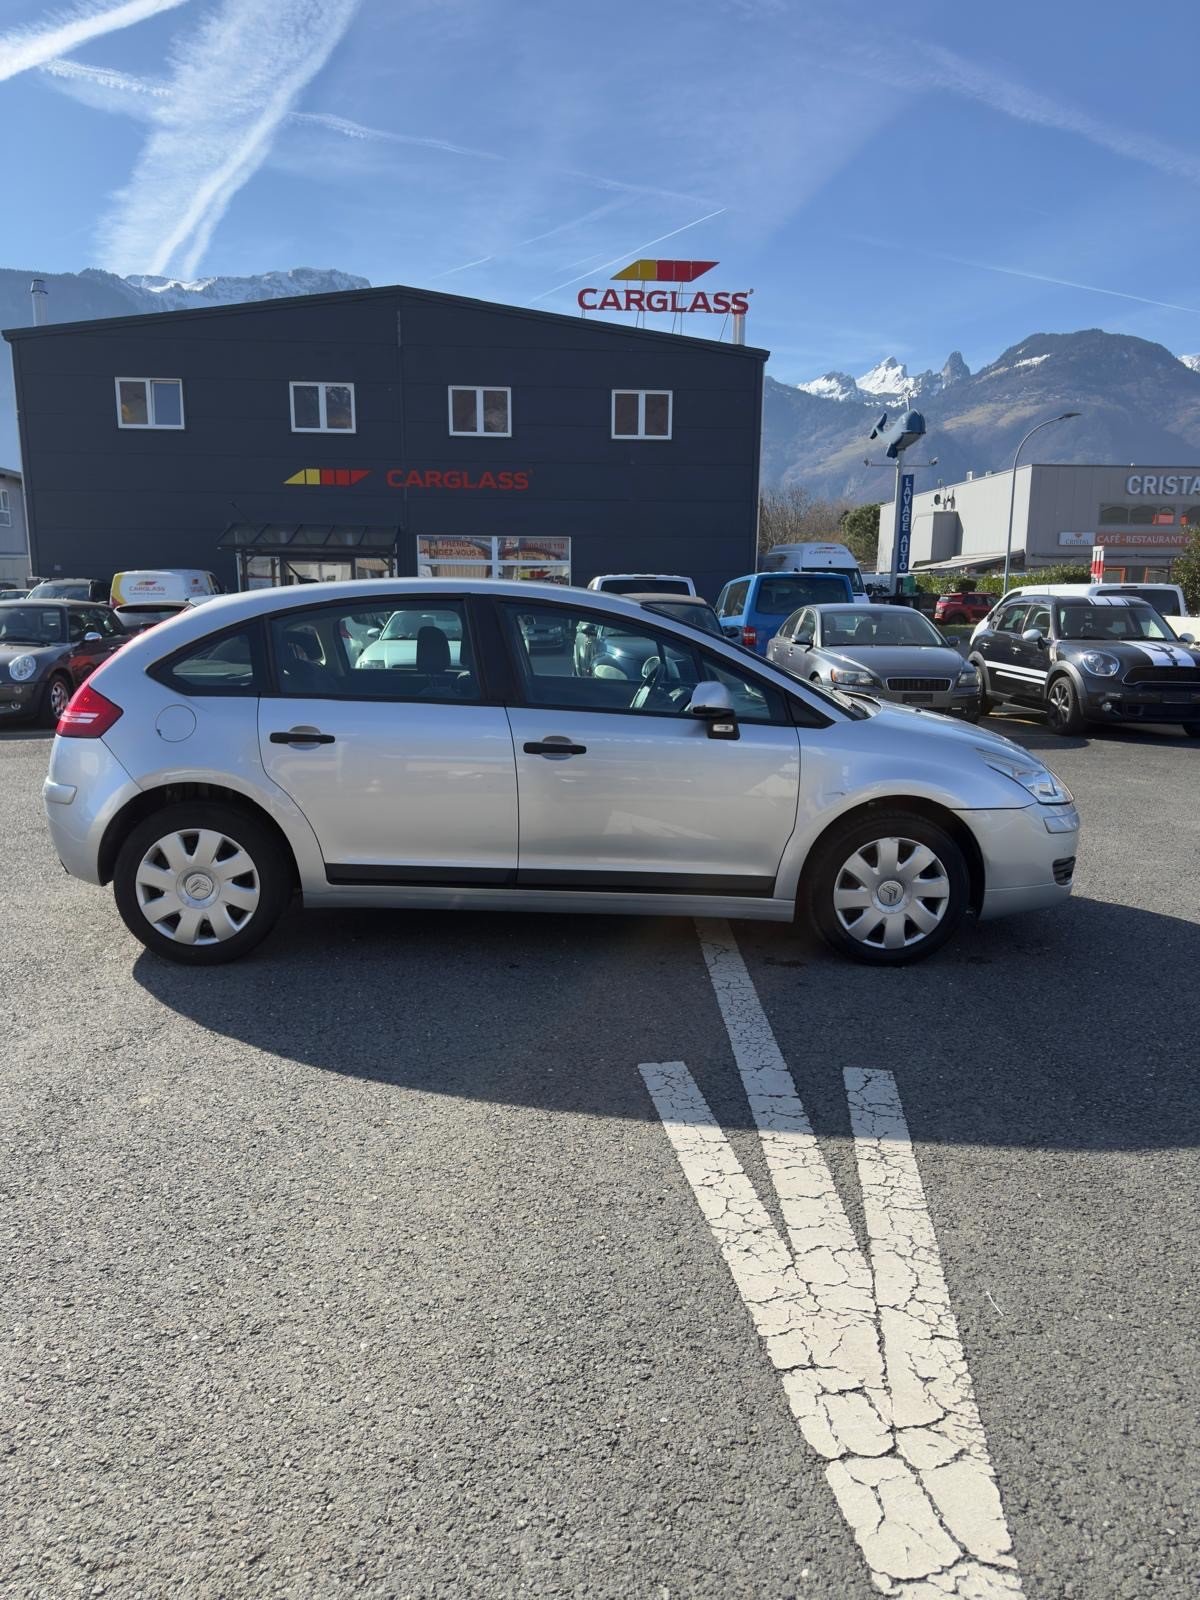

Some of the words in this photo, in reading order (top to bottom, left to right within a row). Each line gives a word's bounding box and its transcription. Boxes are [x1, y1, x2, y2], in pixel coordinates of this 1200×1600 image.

[902, 478, 911, 531] LAVAGE
[899, 535, 908, 570] AUTO
[1097, 534, 1120, 544] CAFÉ
[1126, 535, 1180, 544] RESTAURANT
